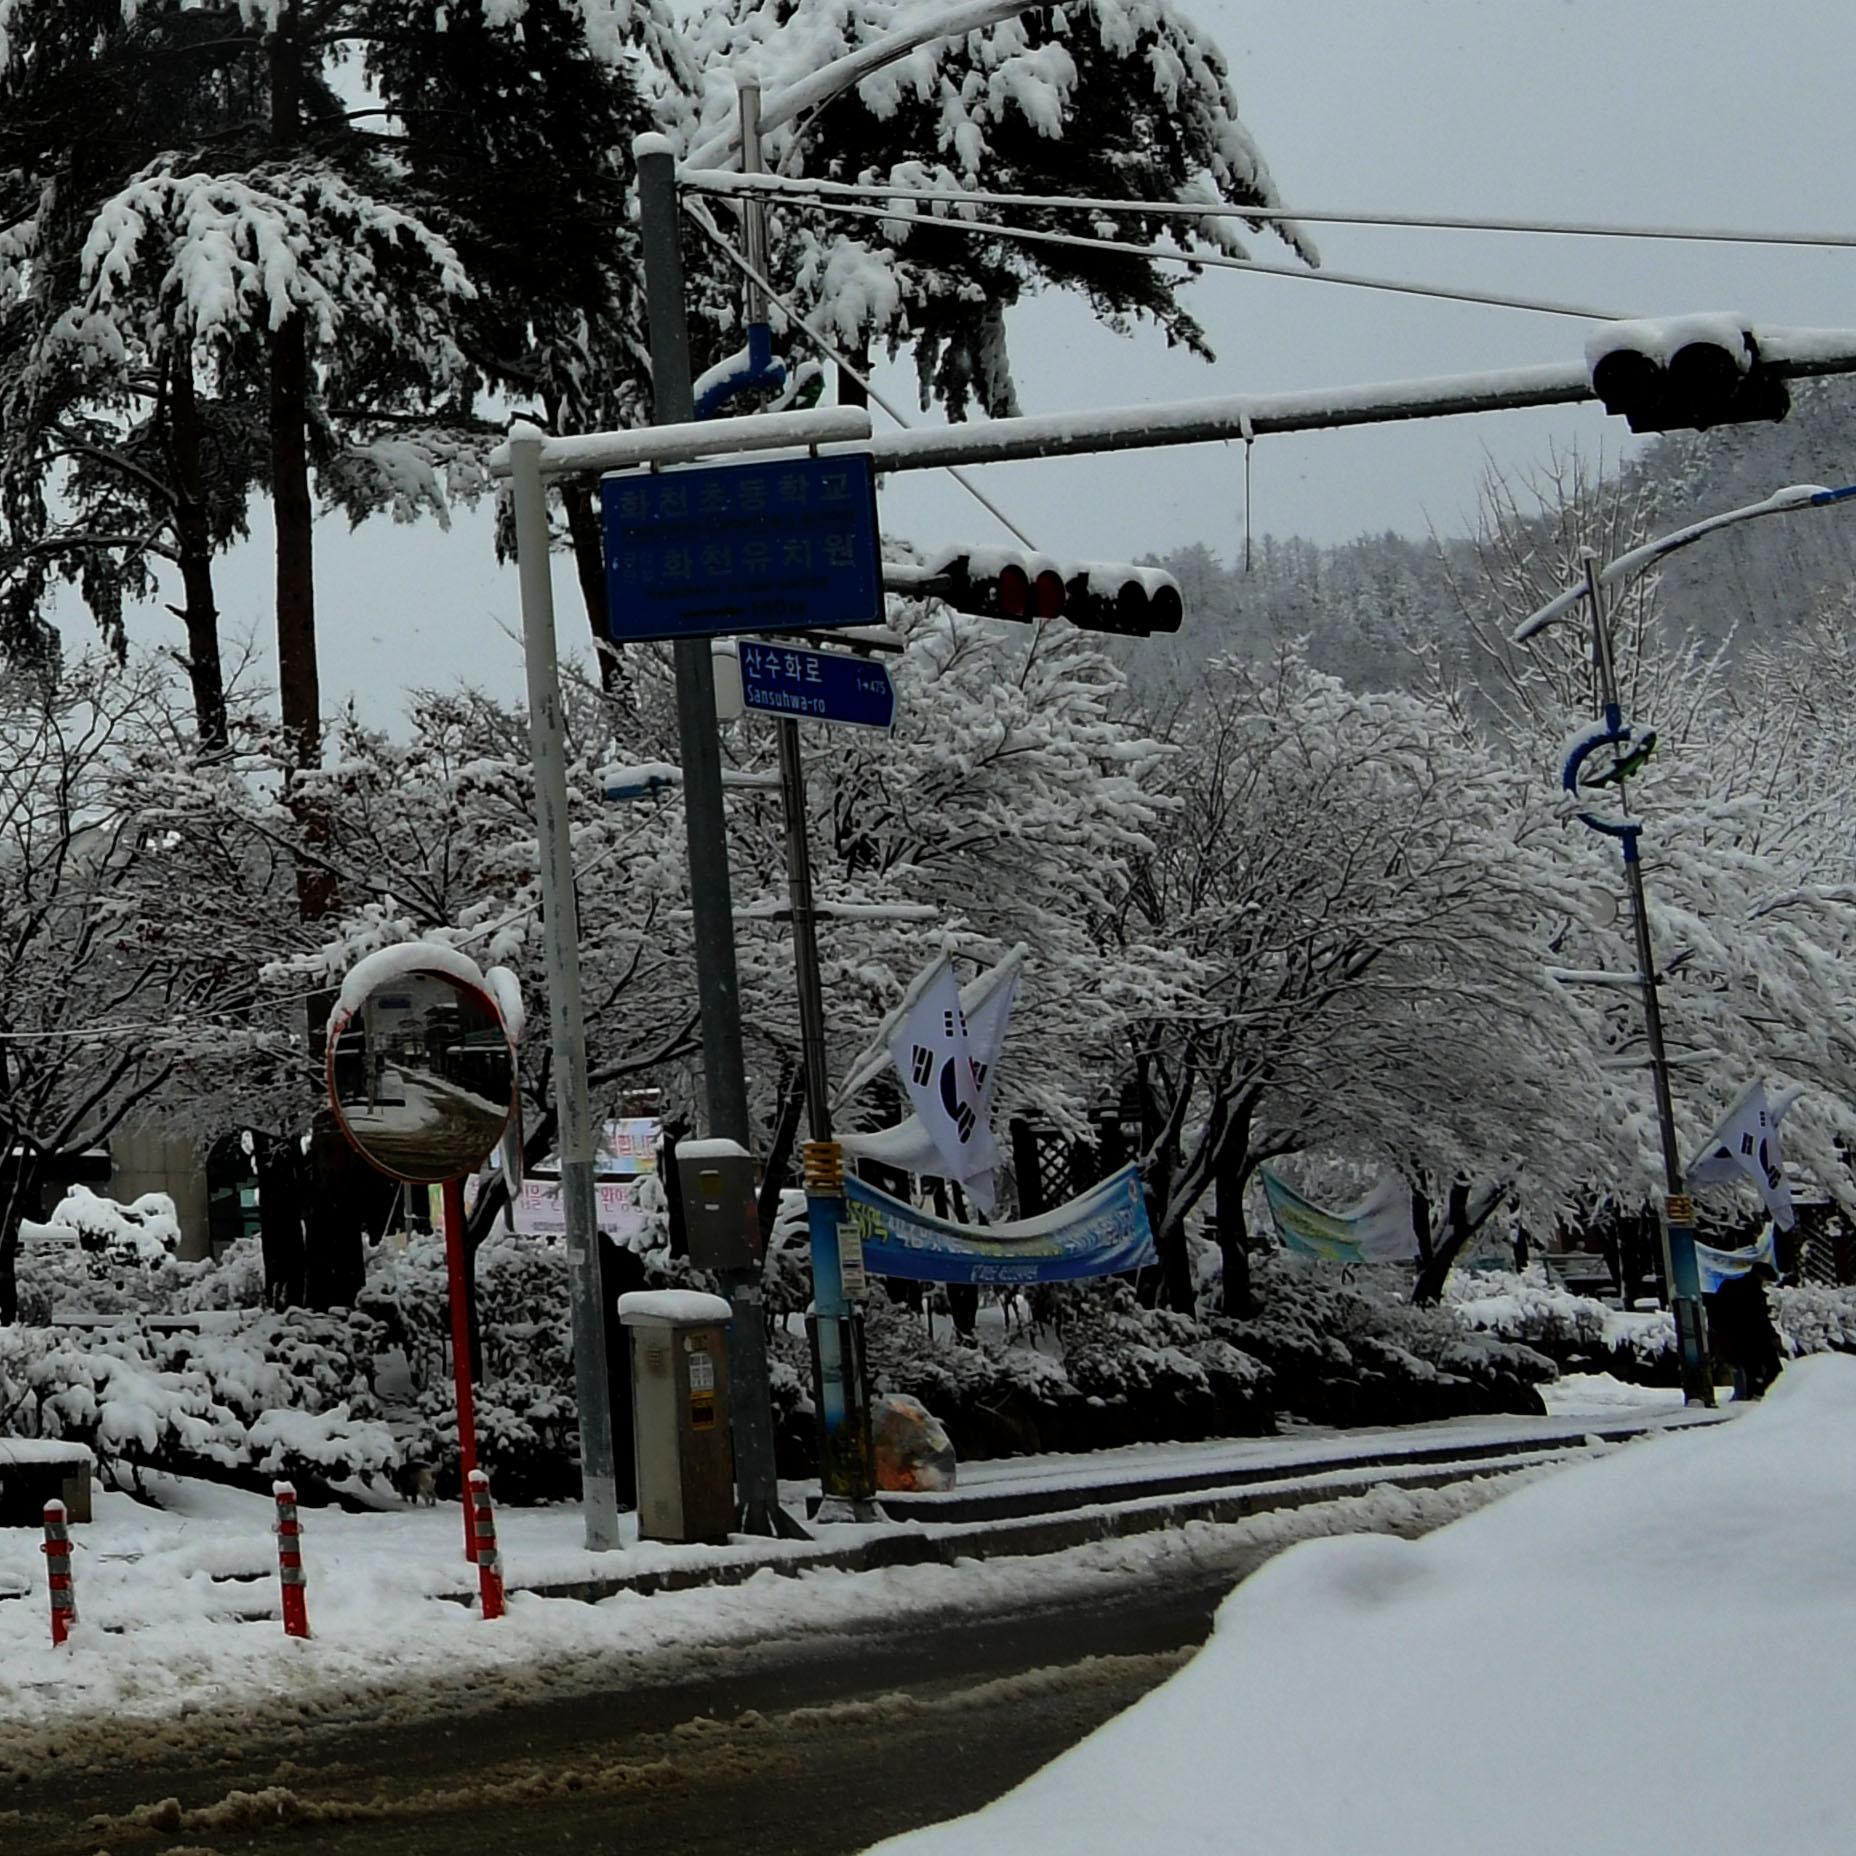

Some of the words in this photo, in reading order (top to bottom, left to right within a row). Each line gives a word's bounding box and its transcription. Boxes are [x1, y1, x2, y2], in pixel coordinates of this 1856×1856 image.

[618, 473, 853, 520] 화천초등학교
[745, 647, 823, 683] 산수화로
[746, 684, 826, 714] Sansuhwa-ro
